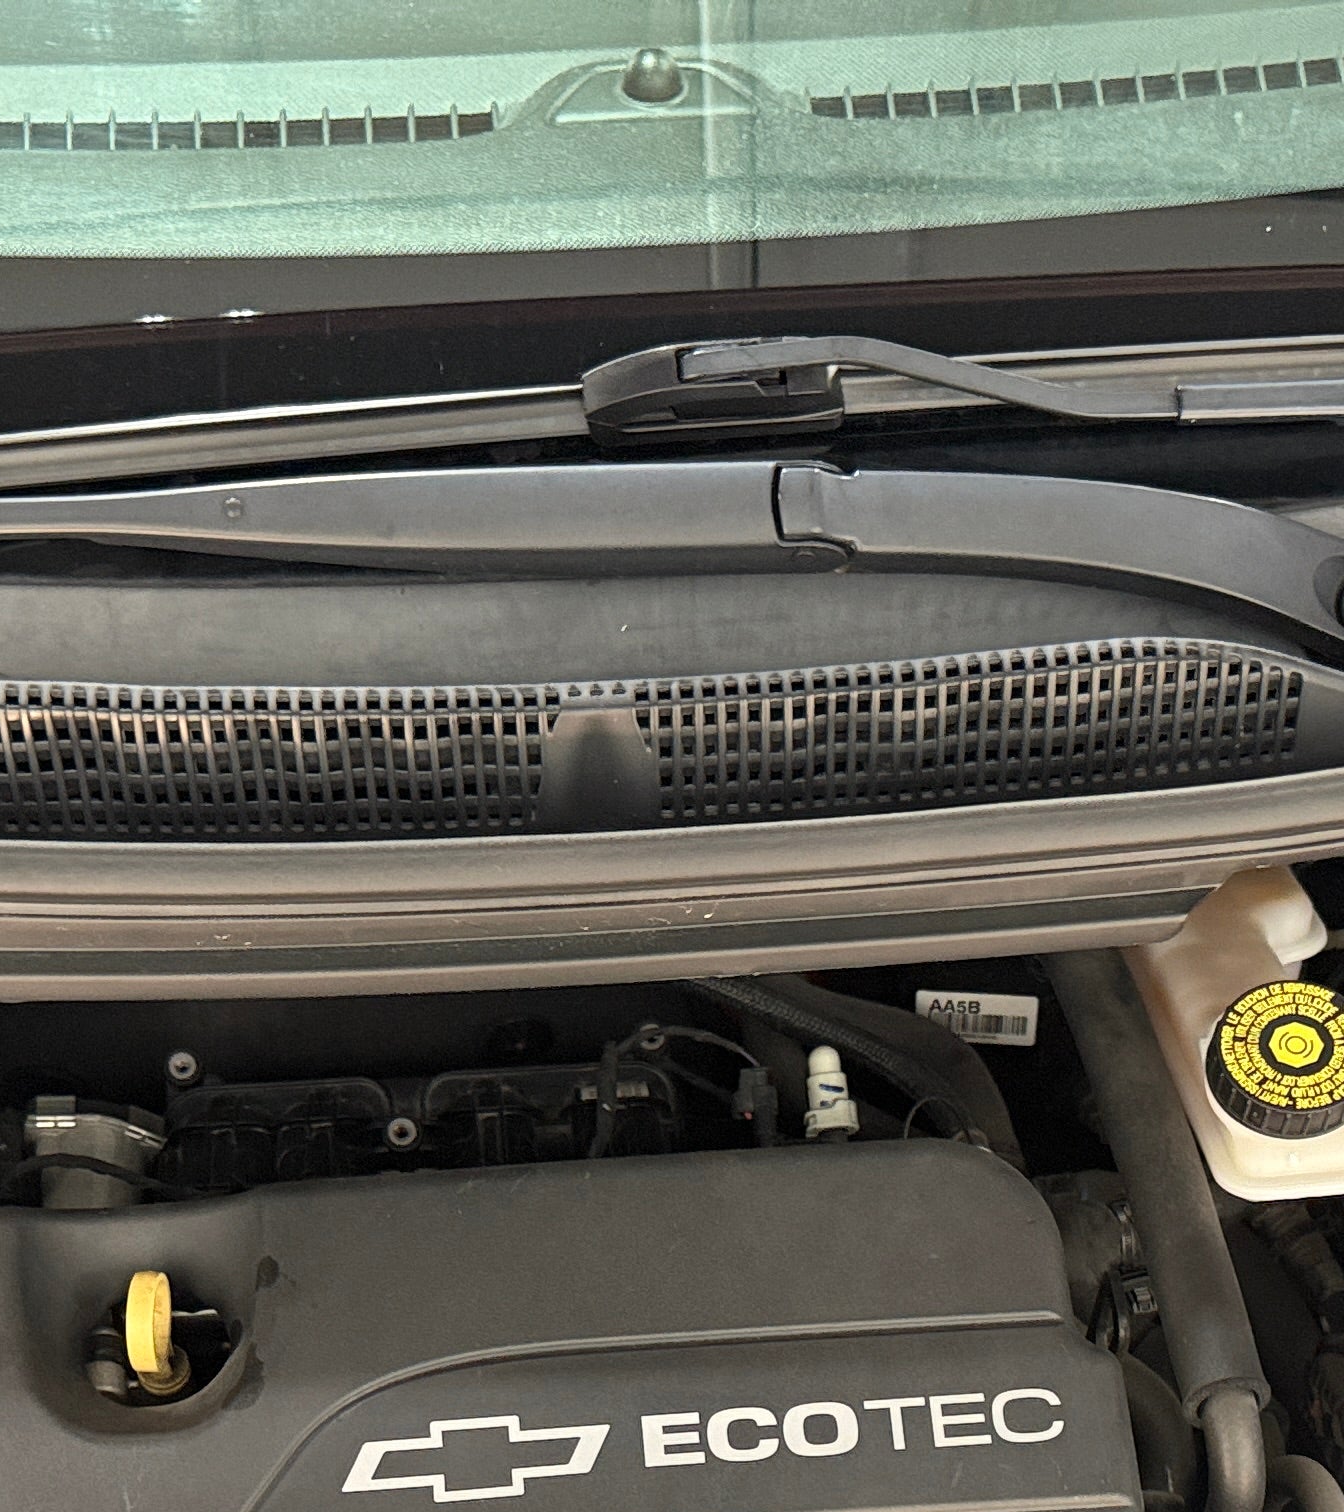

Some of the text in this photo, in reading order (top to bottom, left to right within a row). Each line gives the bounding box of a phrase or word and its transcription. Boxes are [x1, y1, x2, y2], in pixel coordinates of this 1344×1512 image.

[929, 998, 981, 1014] AA5B
[1226, 1012, 1240, 1024] LE
[1269, 984, 1282, 994] DE
[641, 1386, 1066, 1469] ECOTEC
